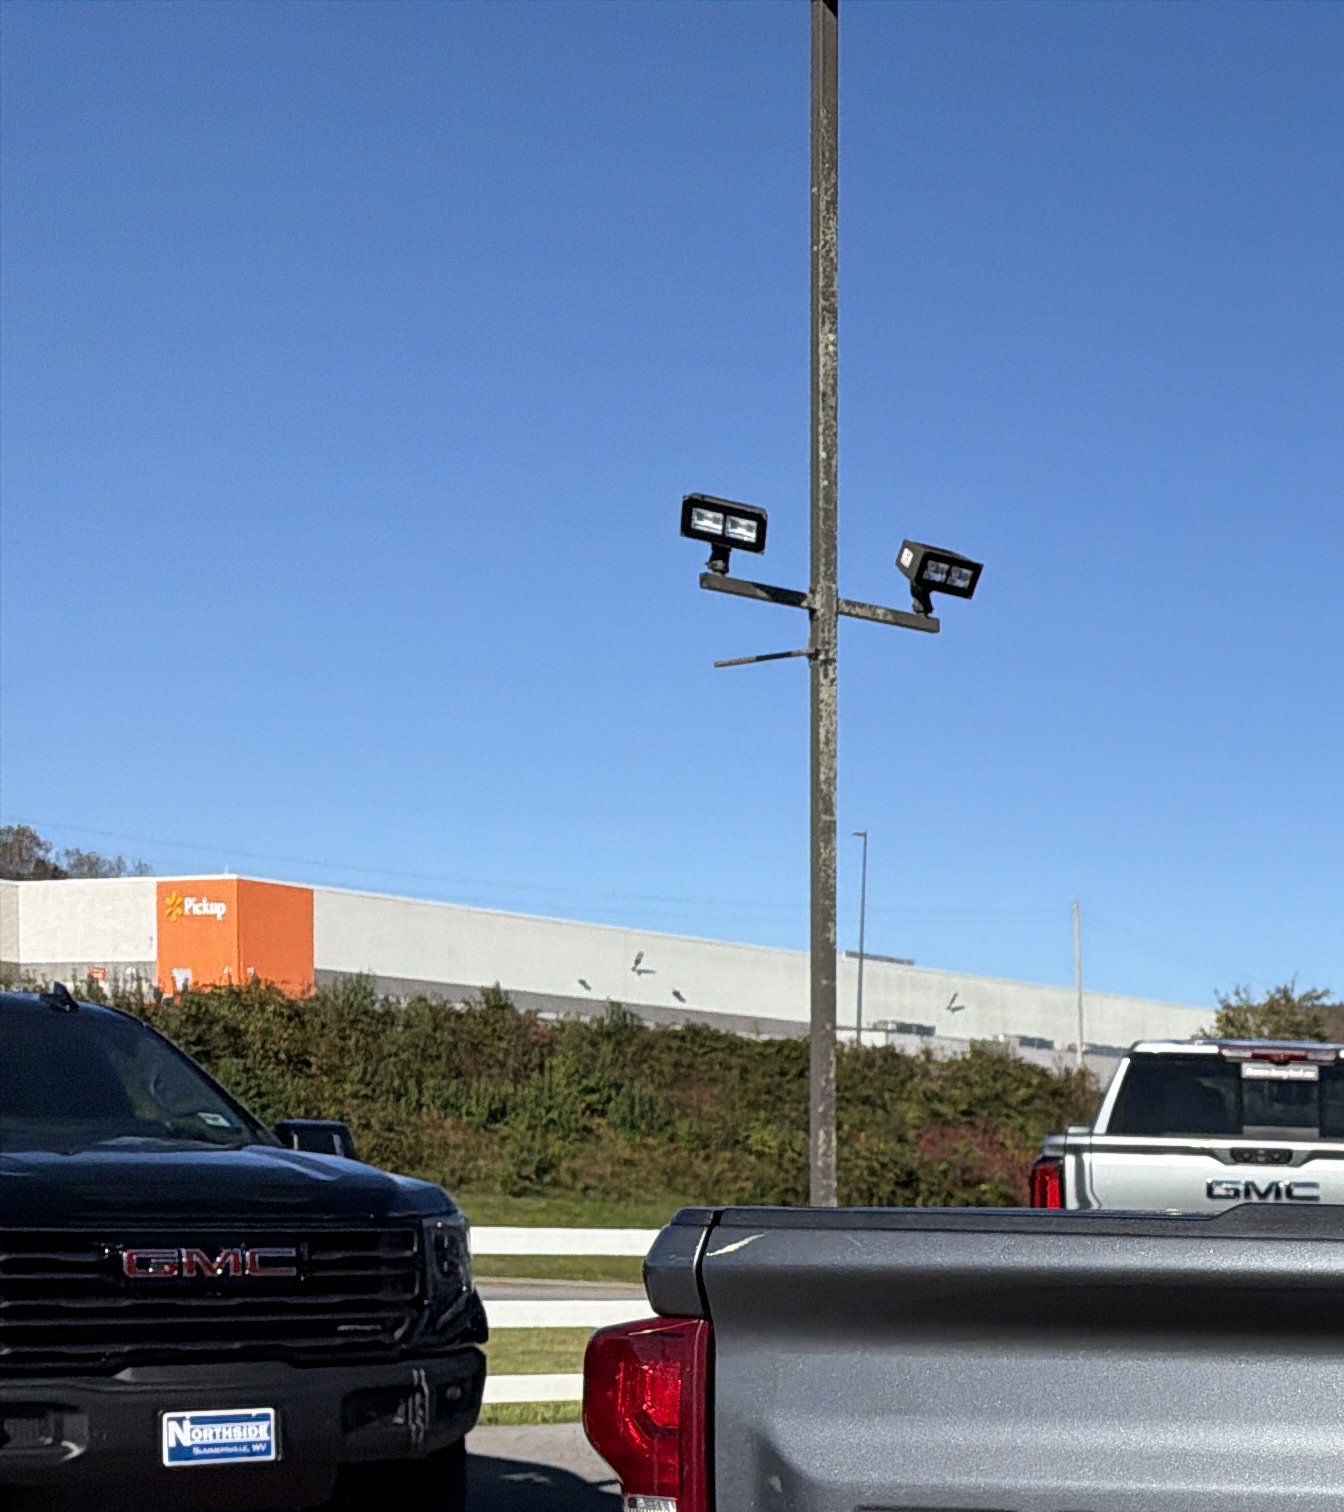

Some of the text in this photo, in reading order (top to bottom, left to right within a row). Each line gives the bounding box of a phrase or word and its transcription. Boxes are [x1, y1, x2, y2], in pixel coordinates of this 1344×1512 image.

[183, 896, 227, 921] Pickup
[1206, 1179, 1320, 1201] GMC
[123, 1248, 297, 1278] GMC
[168, 1420, 270, 1447] NORTHSIDE
